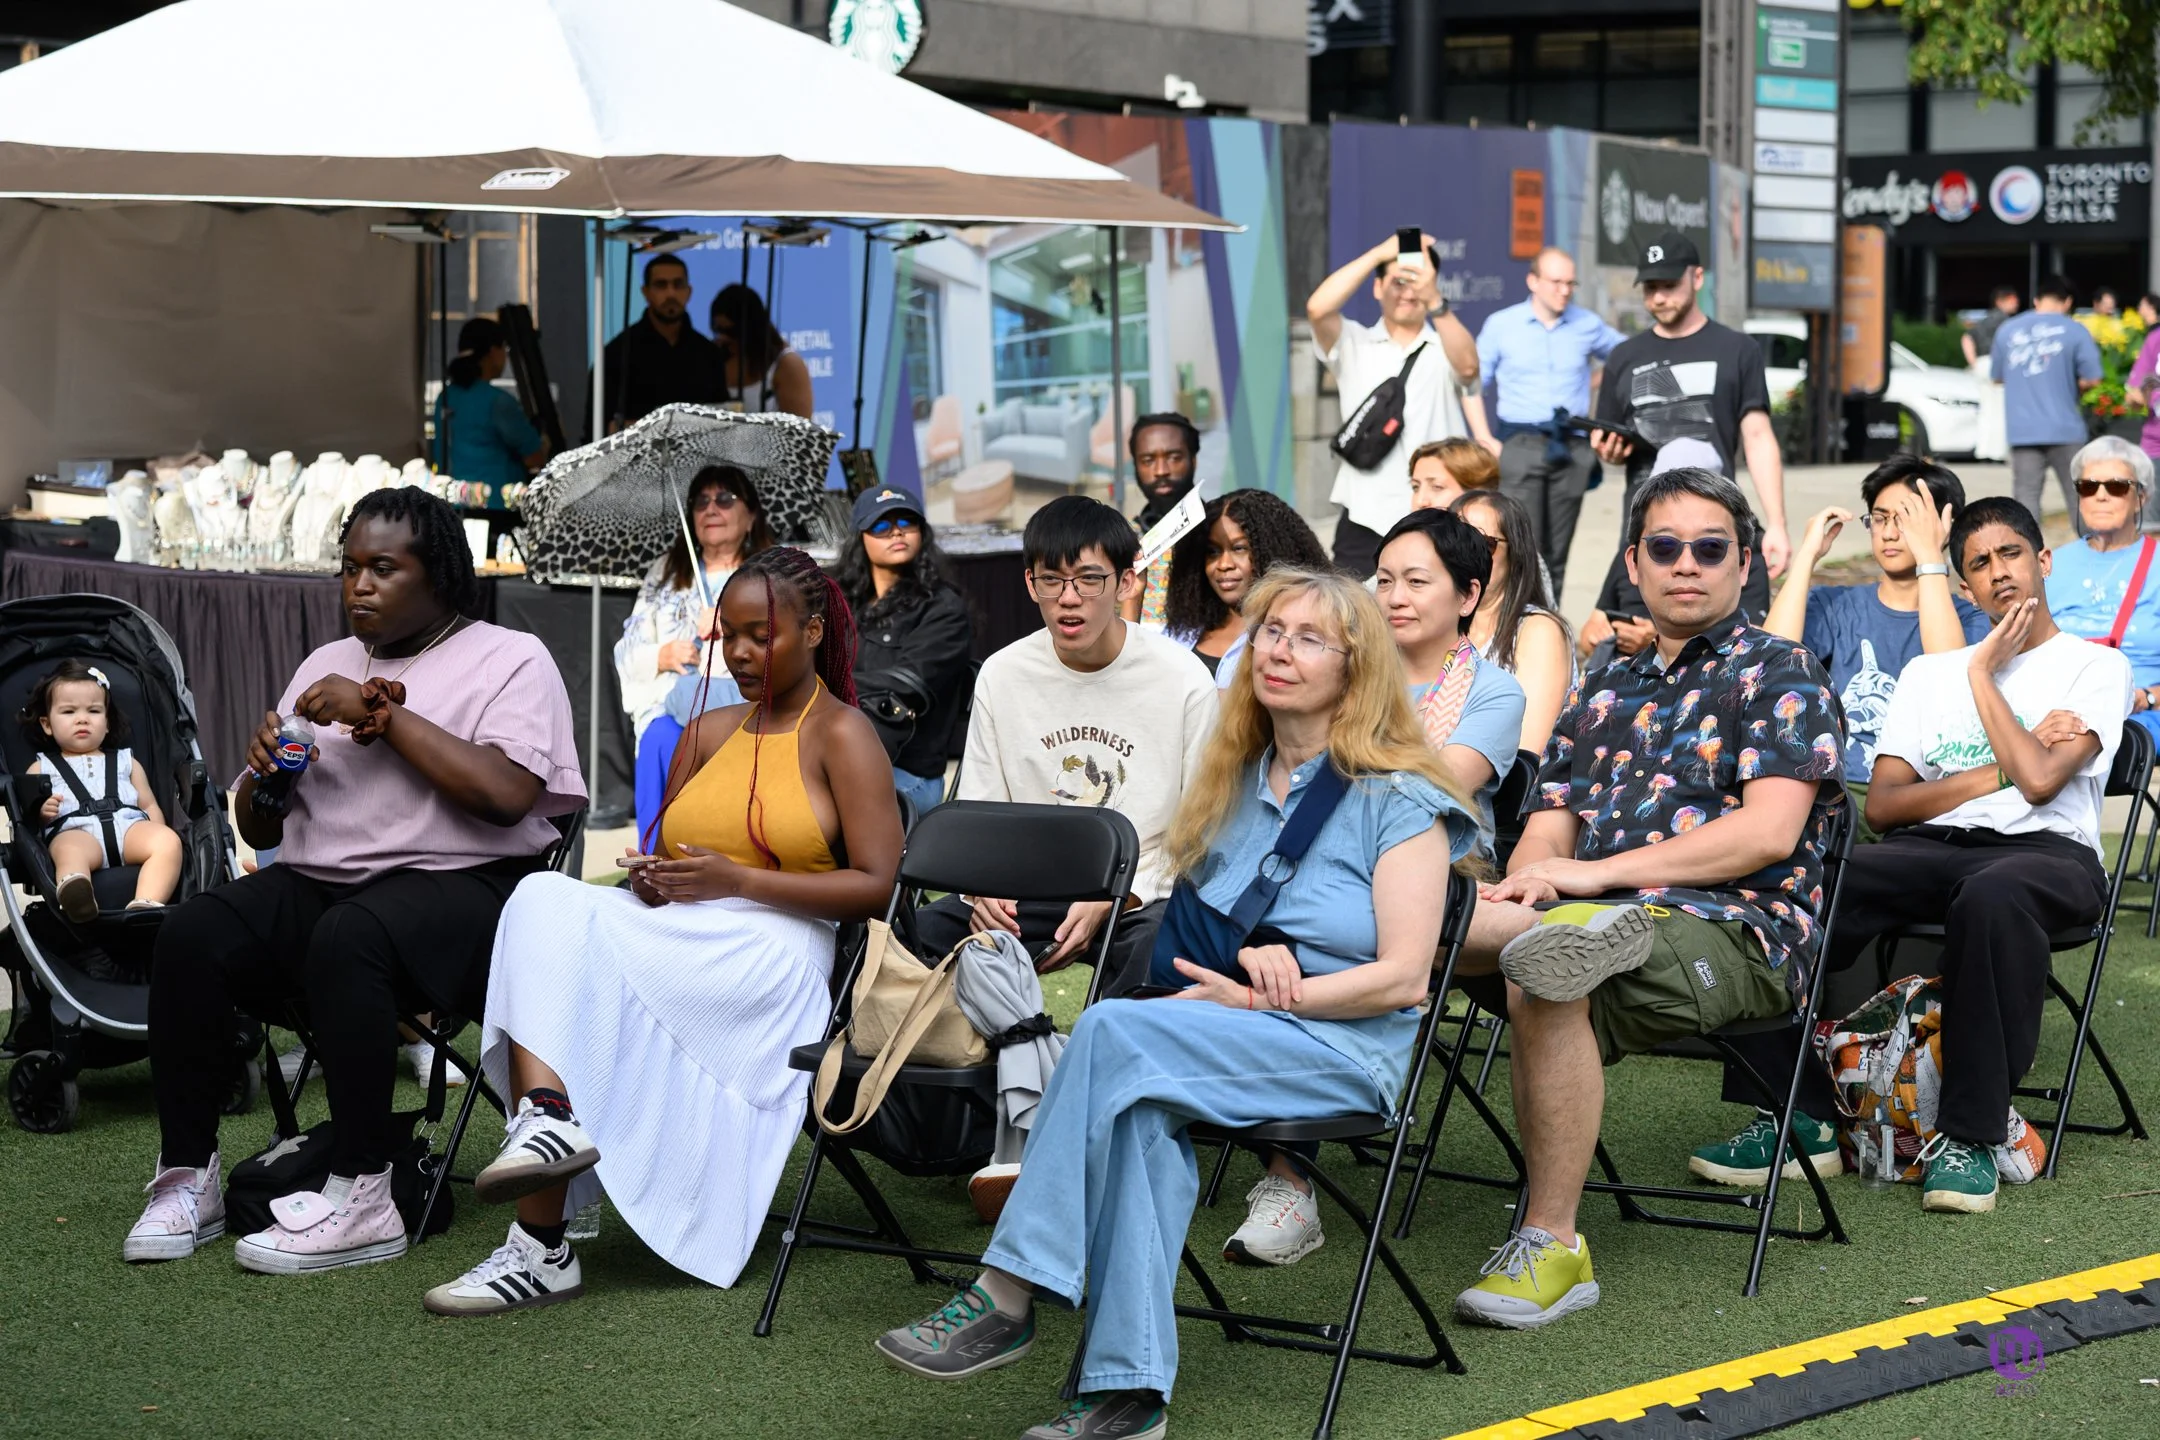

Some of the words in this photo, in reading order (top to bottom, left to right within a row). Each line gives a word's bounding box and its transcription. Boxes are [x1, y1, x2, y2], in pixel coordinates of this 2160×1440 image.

[2045, 162, 2151, 185] TORONTO
[1843, 170, 1930, 225] endy's
[2045, 185, 2119, 204] DANCE
[1634, 190, 1665, 224] Now
[2045, 205, 2117, 223] SALSA
[790, 330, 833, 351] RETAIL
[1040, 726, 1134, 758] WILDERNESS
[283, 750, 304, 759] PEPSI
